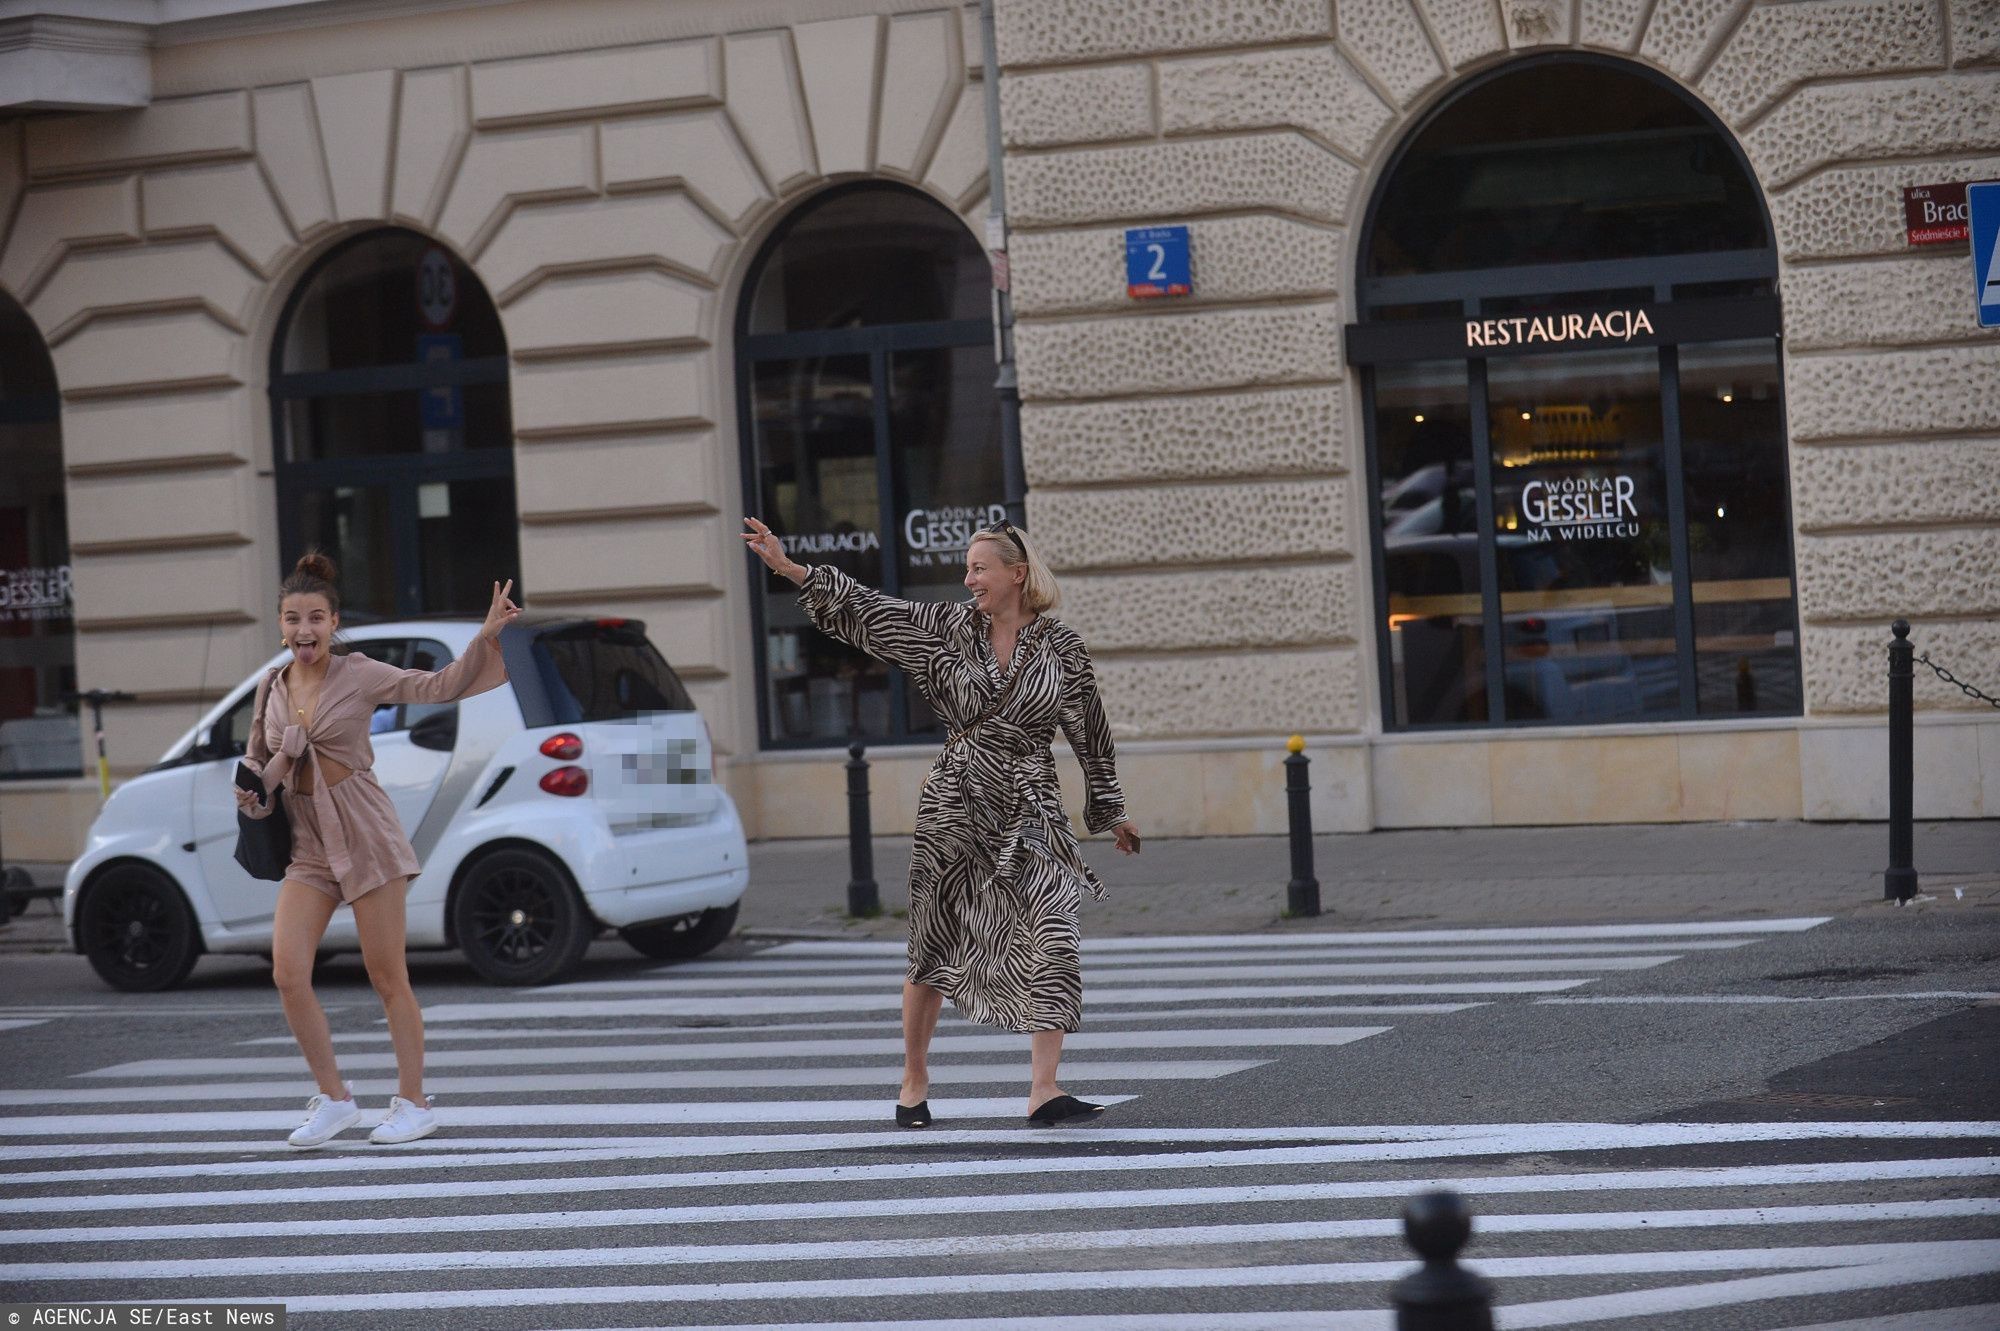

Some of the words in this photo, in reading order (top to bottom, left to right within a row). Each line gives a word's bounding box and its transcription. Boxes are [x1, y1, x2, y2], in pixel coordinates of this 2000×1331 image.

[1911, 188, 1931, 200] ulica
[1923, 201, 1969, 223] Brac
[1147, 244, 1167, 280] 2
[1466, 309, 1654, 347] RESTAURACJA
[1544, 477, 1613, 494] WÓDKA
[1522, 475, 1638, 523] GESSLER
[1527, 528, 1551, 543] NA
[1559, 523, 1640, 540] WIDELCU
